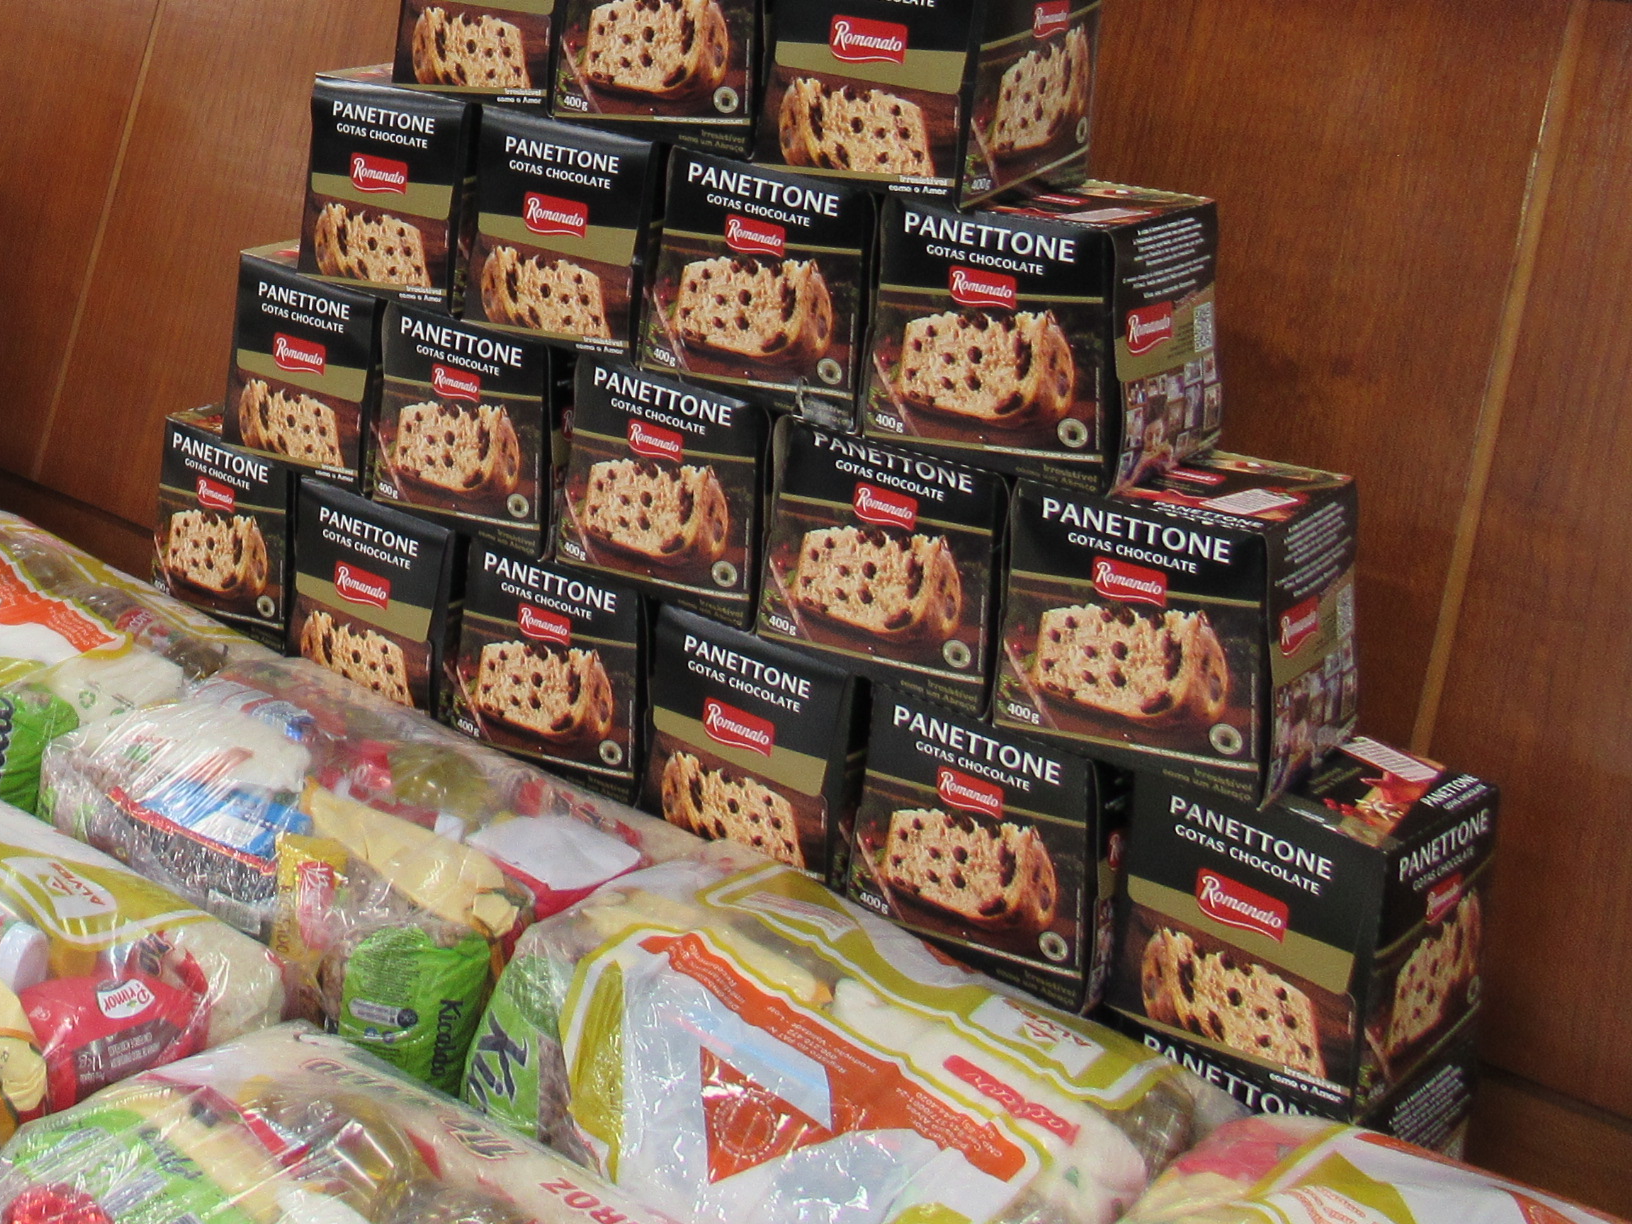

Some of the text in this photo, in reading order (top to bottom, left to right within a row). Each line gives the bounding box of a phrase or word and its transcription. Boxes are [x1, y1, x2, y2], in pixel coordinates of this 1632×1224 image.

[834, 20, 902, 52] Romanato
[332, 100, 436, 135] PANETTONE
[336, 123, 428, 149] GOTAS CHOCOLATE
[353, 157, 404, 185] Romanato
[505, 136, 620, 174] PANETTONE
[509, 159, 611, 190] GOTAS CHOCOLATE
[688, 162, 840, 217] PANETTONE
[527, 197, 584, 227] Romanato
[706, 193, 810, 227] GOTAS CHOCOLATE
[727, 218, 782, 247] Romanato
[904, 211, 1076, 264] PANETTONE
[926, 244, 1044, 276] GOTAS CHOCOLATE
[258, 281, 350, 320] PANETTONE
[953, 270, 1012, 298] Romanato
[261, 303, 344, 334] GOTAS CHOCOLATE
[276, 338, 323, 366] Romanato
[400, 316, 522, 368] PANETTONE
[416, 345, 500, 377] GOTAS CHOCOLATE
[434, 367, 477, 394] Romanato
[594, 367, 732, 427] PANETTONE
[611, 397, 705, 435] GOTAS CHOCOLATE
[173, 432, 268, 483] PANETTONE
[630, 424, 679, 453] Romanato
[185, 458, 250, 490] GOTAS CHOCOLATE
[813, 431, 973, 494] PANETTONE
[836, 460, 944, 502] GOTAS CHOCOLATE
[198, 479, 233, 504] Romanato
[857, 487, 913, 520] Romanato
[319, 506, 419, 557] PANETTONE
[322, 529, 411, 570] GOTAS CHOCOLATE
[1042, 496, 1232, 565] PANETTONE
[1068, 531, 1197, 574] GOTAS CHOCOLATE
[337, 565, 387, 600] Romanato
[484, 551, 617, 613] PANETTONE
[1097, 561, 1163, 595] Romanato
[501, 581, 592, 621] GOTAS CHOCOLATE
[520, 607, 568, 637] Romanato
[684, 634, 811, 700] PANETTONE
[688, 660, 801, 713] GOTAS CHOCOLATE
[707, 702, 770, 745] Romanato
[892, 704, 1061, 786] PANETTONE
[916, 741, 1030, 792] GOTAS CHOCOLATE
[941, 771, 998, 807] Romanato
[1170, 795, 1333, 881] PANETTONE
[1398, 808, 1490, 882] PANETTONE
[1175, 825, 1321, 896] GOTAS CHOCOLATE
[1200, 876, 1282, 929] Romanato
[102, 978, 152, 1015] Primor
